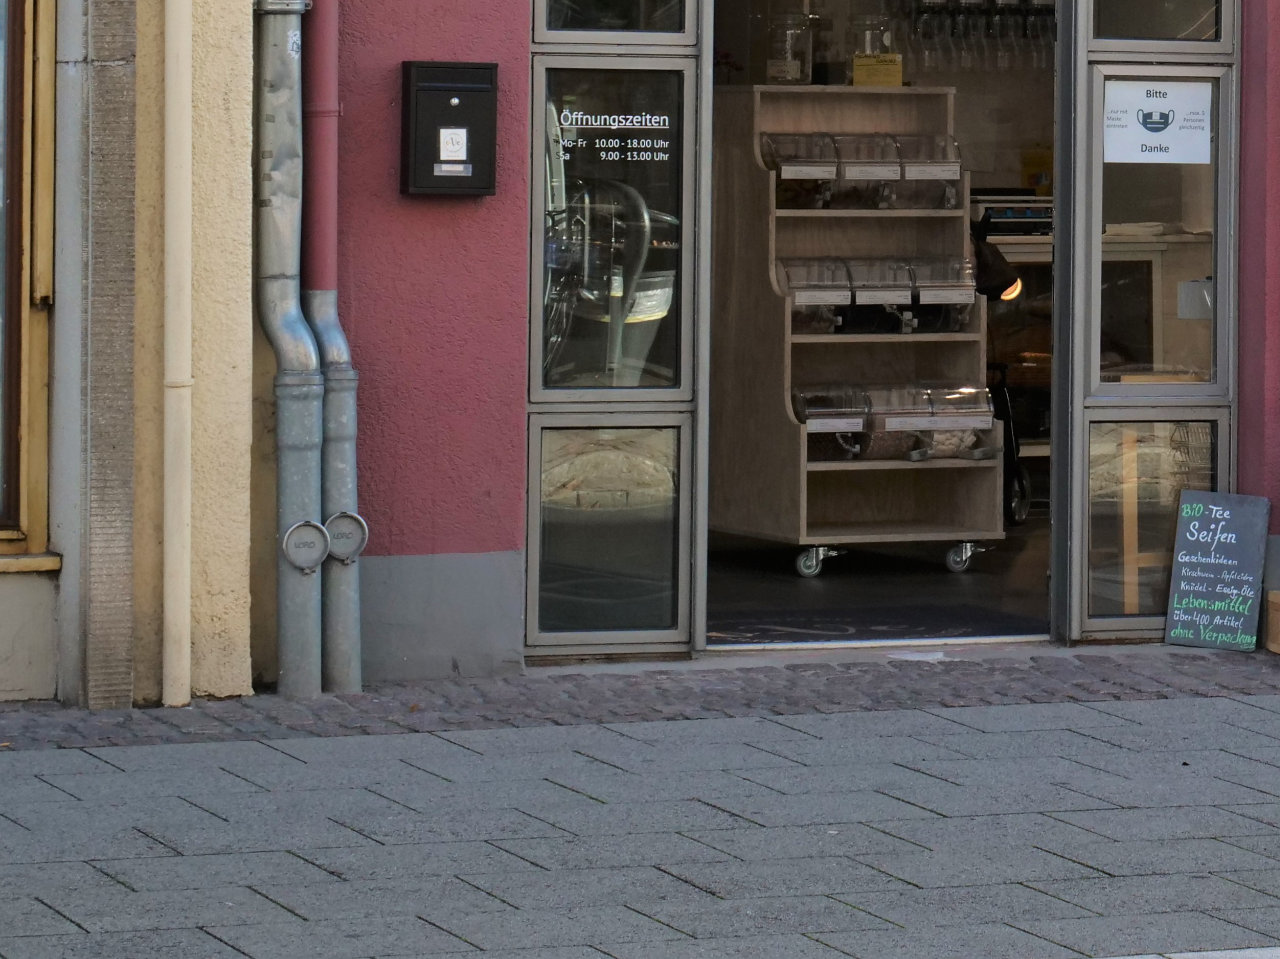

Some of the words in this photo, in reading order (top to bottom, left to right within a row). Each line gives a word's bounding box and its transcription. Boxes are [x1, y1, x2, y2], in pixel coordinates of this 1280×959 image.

[1145, 89, 1168, 99] Bitte
[560, 109, 669, 129] Öffnungszeiten
[594, 139, 620, 148] 10.00
[626, 139, 652, 148] 18.00
[654, 139, 670, 148] Uhr
[1140, 144, 1170, 153] Danke
[560, 152, 571, 160] Sa
[600, 151, 620, 161] 9.00
[626, 151, 652, 161] 13.00
[654, 151, 670, 161] Uhr
[1186, 521, 1237, 552] Seifen
[1178, 550, 1239, 567] Geschenkideen
[1180, 581, 1207, 593] Knödel
[1173, 593, 1253, 616] Lebensmittel
[1173, 609, 1191, 621] über
[1193, 611, 1210, 626] 400
[1213, 615, 1244, 629] Artikel
[1170, 622, 1195, 639] ohne
